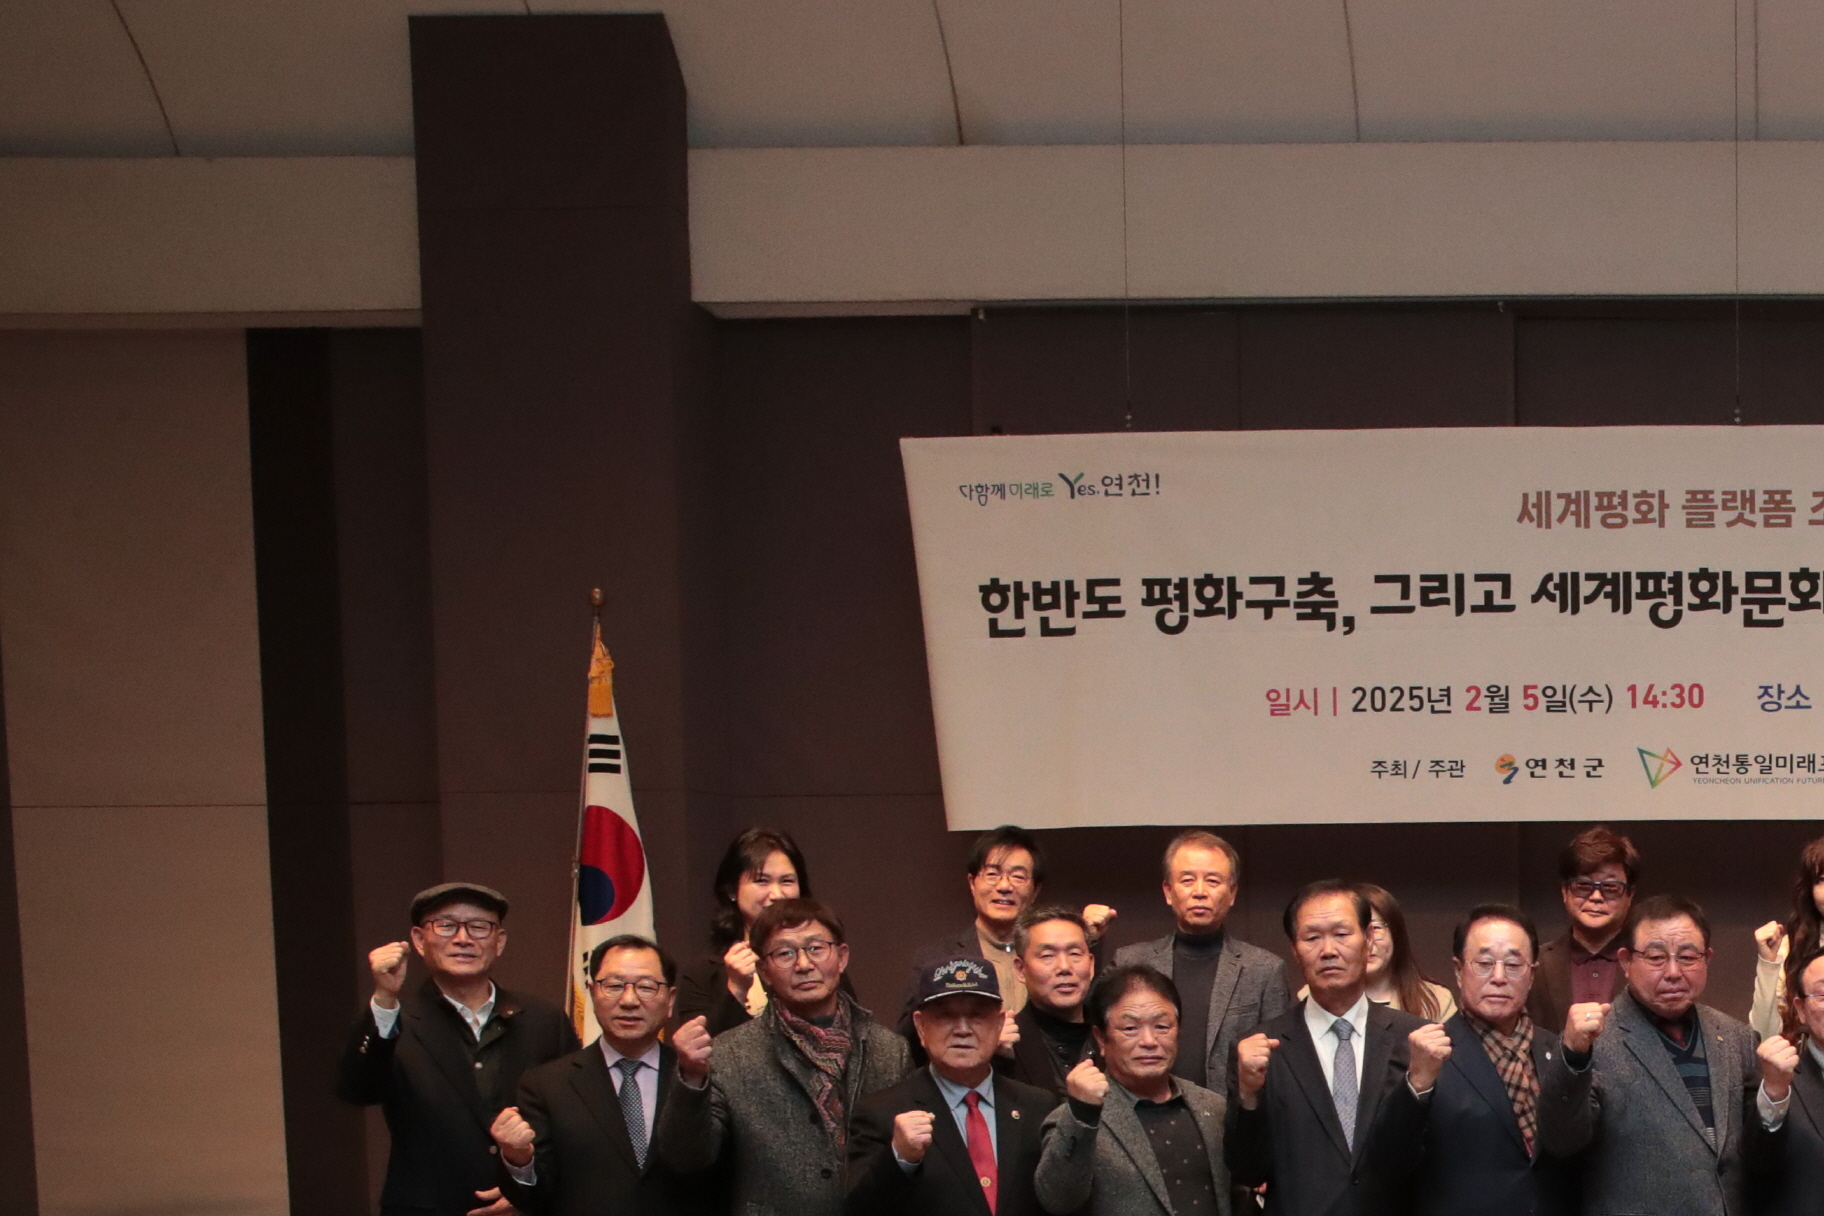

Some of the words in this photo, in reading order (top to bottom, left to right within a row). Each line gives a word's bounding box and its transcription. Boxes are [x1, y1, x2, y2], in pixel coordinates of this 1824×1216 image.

[959, 483, 1006, 506] 다함께
[1009, 482, 1054, 499] 미래로
[1517, 490, 1670, 529] 세계평화
[1682, 489, 1796, 528] 플랫폼
[978, 577, 1126, 639] 한반도
[1141, 571, 1355, 636] 평화구축,
[1370, 572, 1517, 617] 그리고
[1266, 687, 1318, 716] 일시
[1352, 685, 1452, 714] 2025년
[1465, 684, 1510, 714] 2월
[1523, 684, 1613, 714] 5일(수)
[1627, 683, 1704, 709] 14:30
[1757, 683, 1812, 713] 장소
[1370, 760, 1407, 779] 주최
[1428, 759, 1466, 778] 주관
[1743, 777, 1794, 785] UNIFICATION
